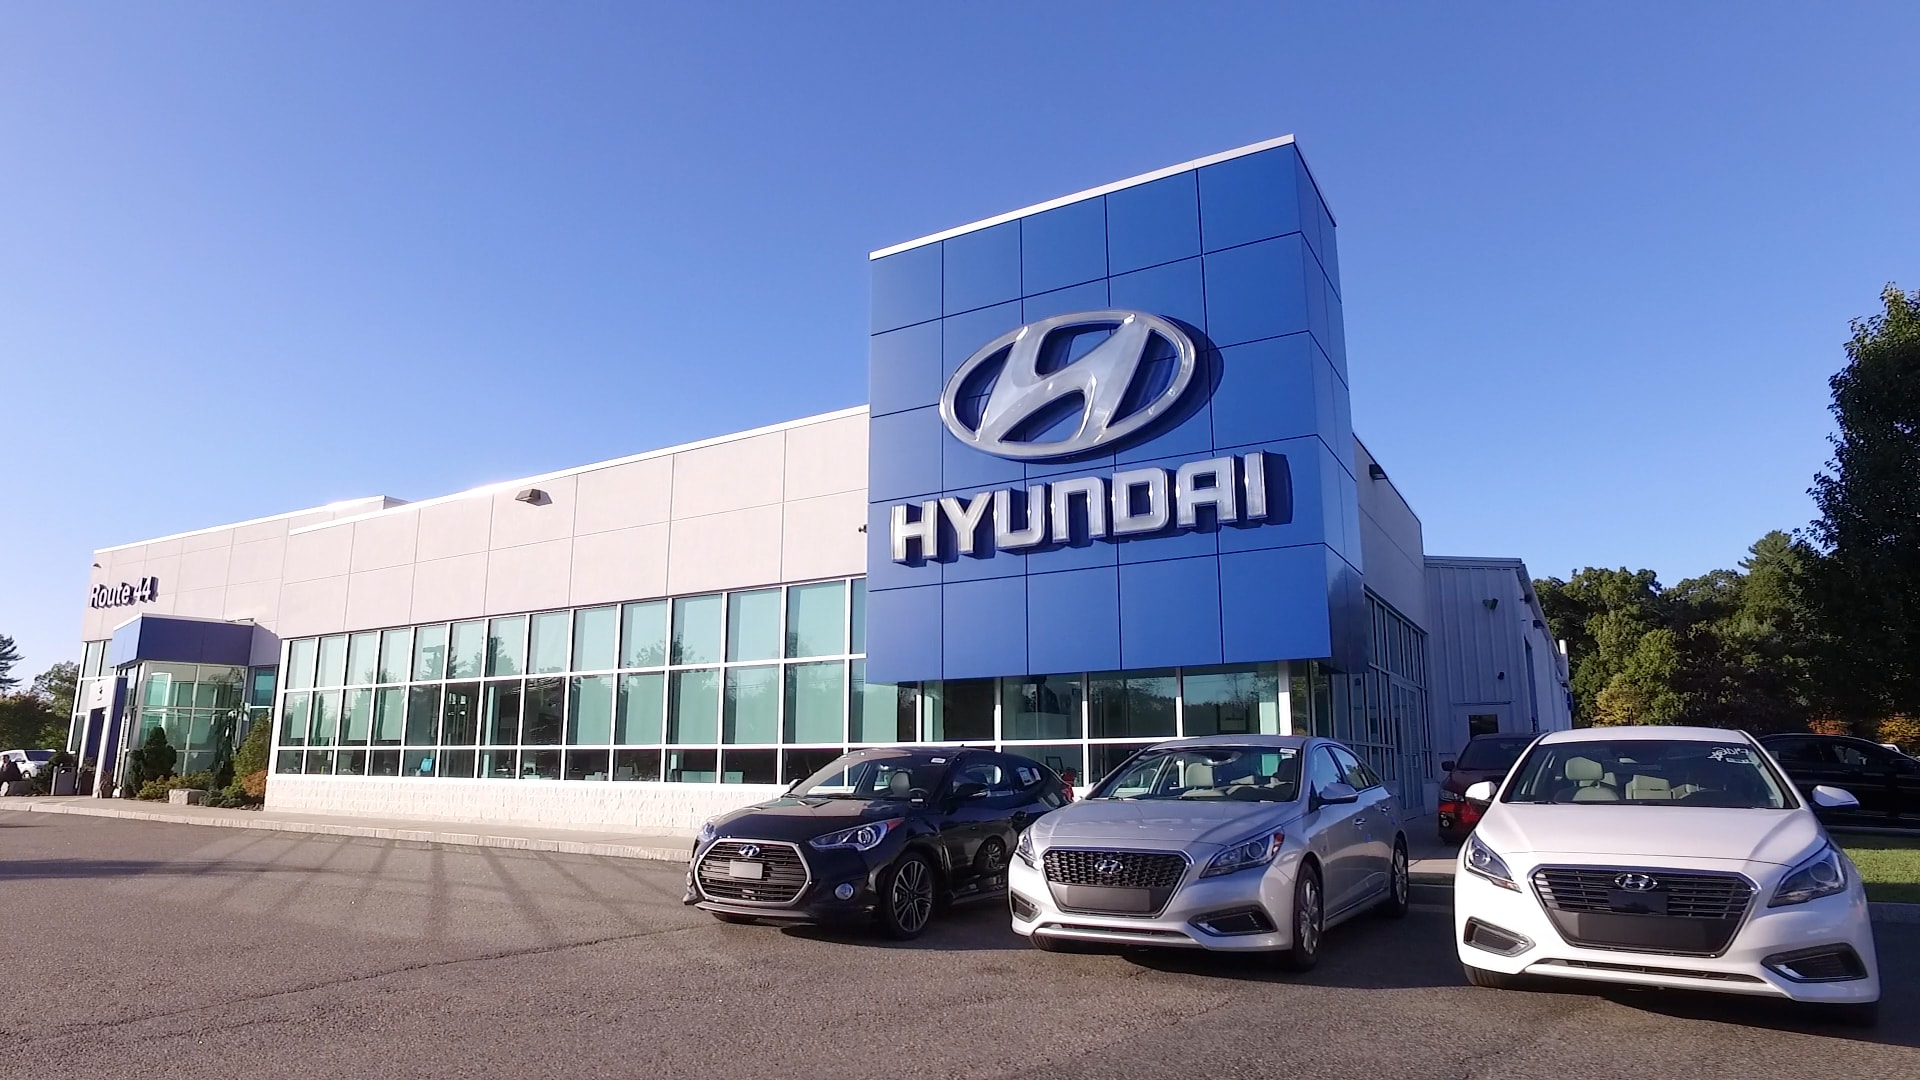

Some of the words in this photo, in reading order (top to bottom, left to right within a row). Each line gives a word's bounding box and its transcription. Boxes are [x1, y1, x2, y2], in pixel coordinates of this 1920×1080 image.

[890, 451, 1269, 563] HYUNDAI
[90, 582, 131, 608] Route
[133, 576, 154, 603] 44
